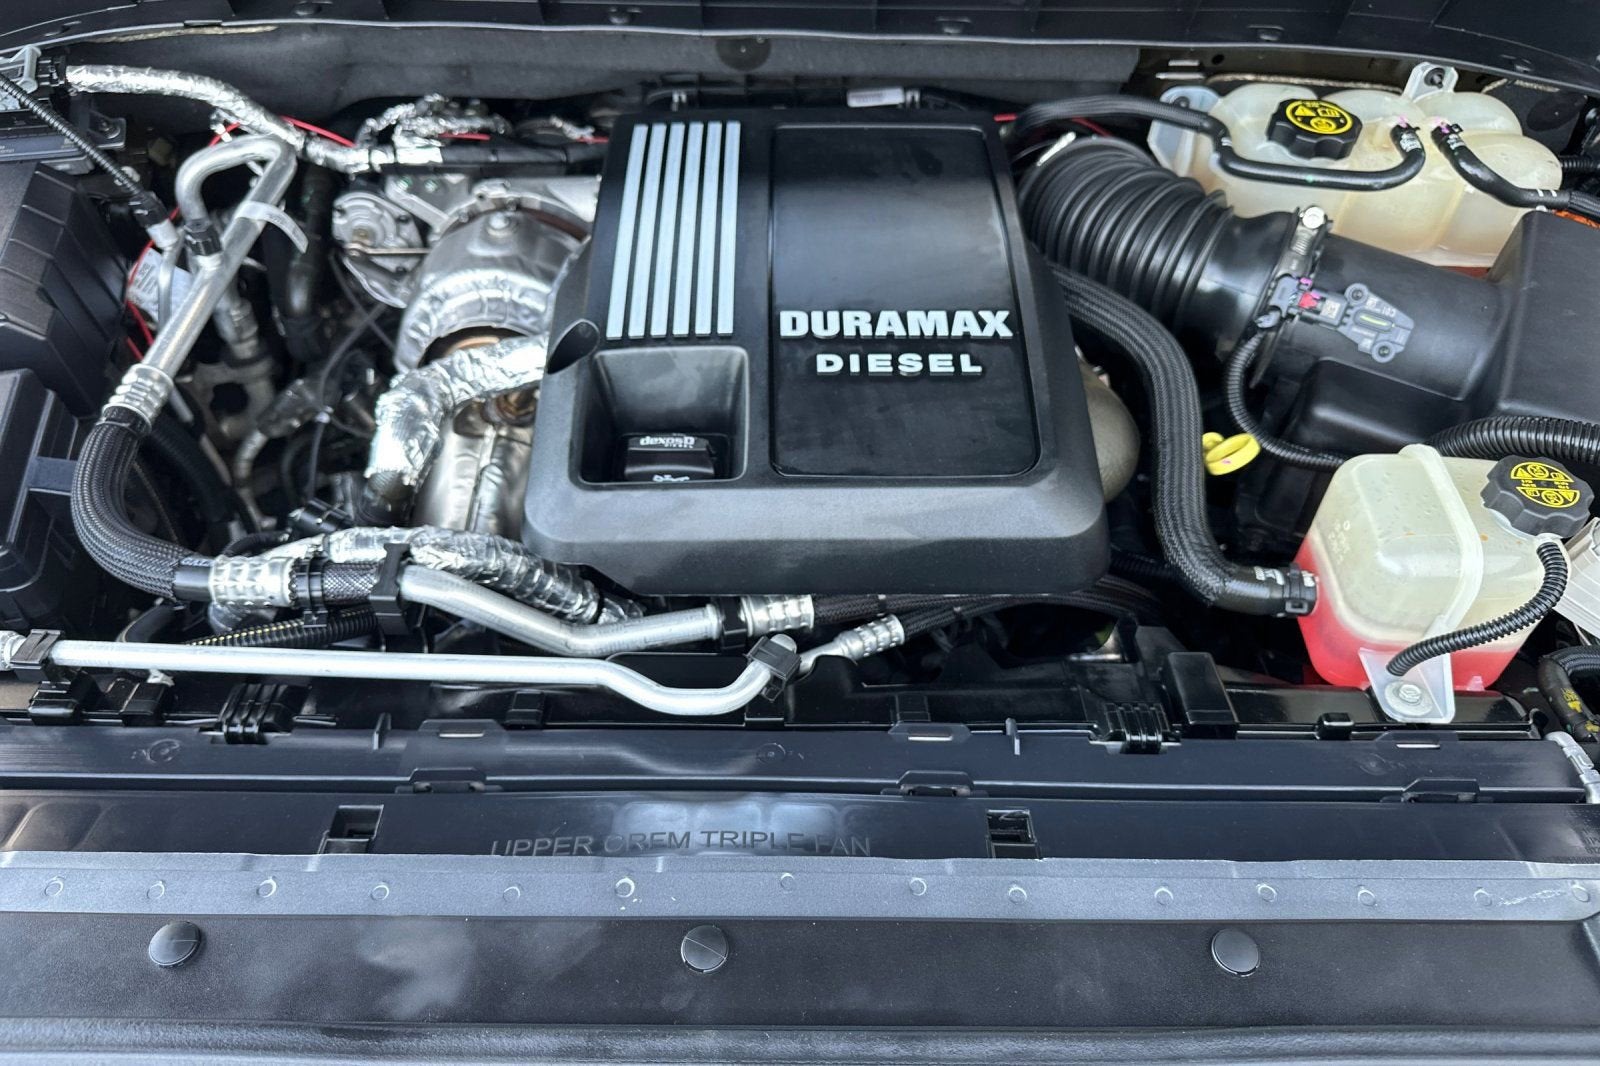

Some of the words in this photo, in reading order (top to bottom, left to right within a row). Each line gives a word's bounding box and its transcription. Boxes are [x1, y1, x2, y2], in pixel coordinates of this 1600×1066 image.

[779, 310, 1014, 339] DURAMAX
[816, 353, 983, 376] DIESEL
[490, 835, 595, 856] UPPER
[700, 830, 804, 851] TRIPLE
[815, 833, 872, 857] FAN
